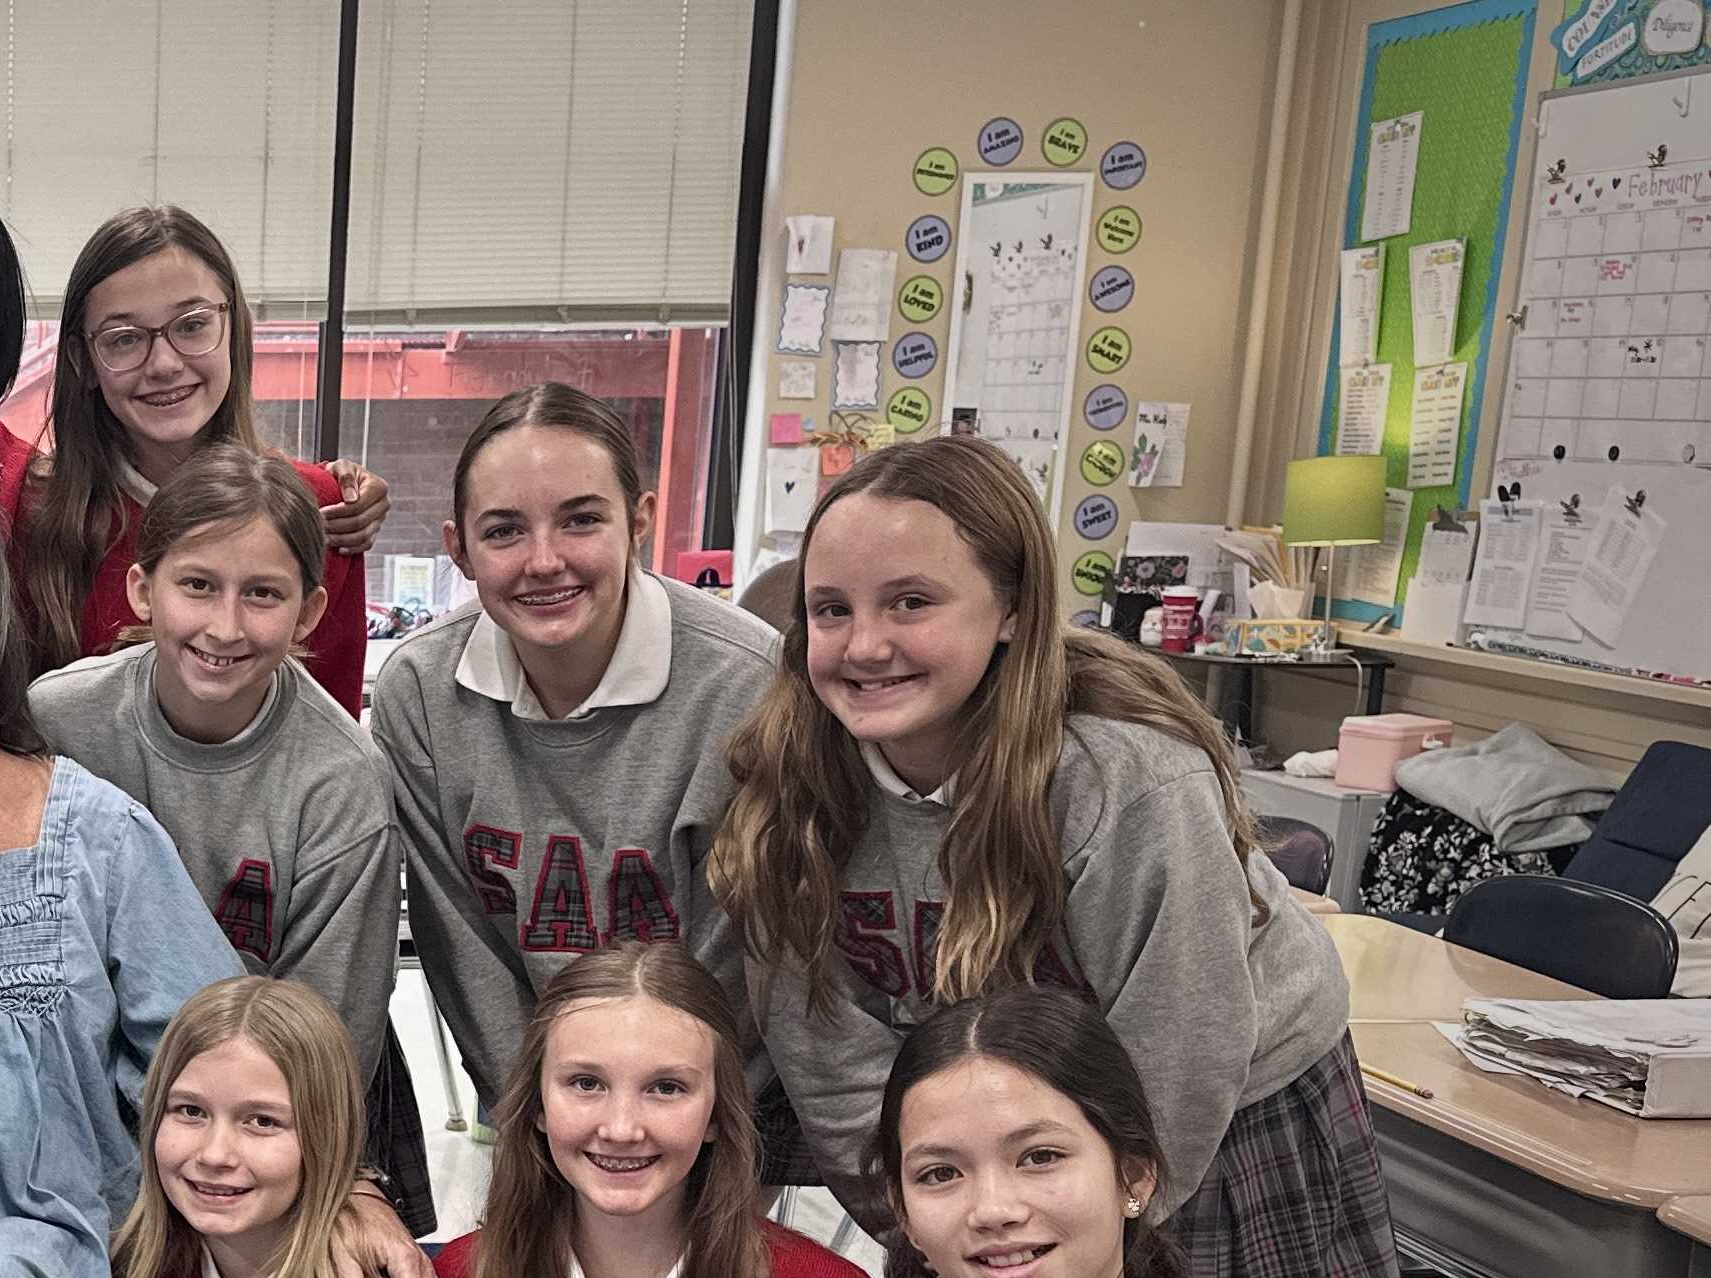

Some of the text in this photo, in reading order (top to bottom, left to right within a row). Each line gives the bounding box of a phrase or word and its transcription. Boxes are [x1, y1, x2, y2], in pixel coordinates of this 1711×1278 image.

[1048, 135, 1081, 154] BRAVE
[1628, 171, 1703, 199] February
[916, 234, 944, 253] KIND
[904, 294, 935, 312] LOVED
[1091, 344, 1122, 365] SMART
[1082, 510, 1112, 529] SWEET
[463, 822, 682, 953] SAA
